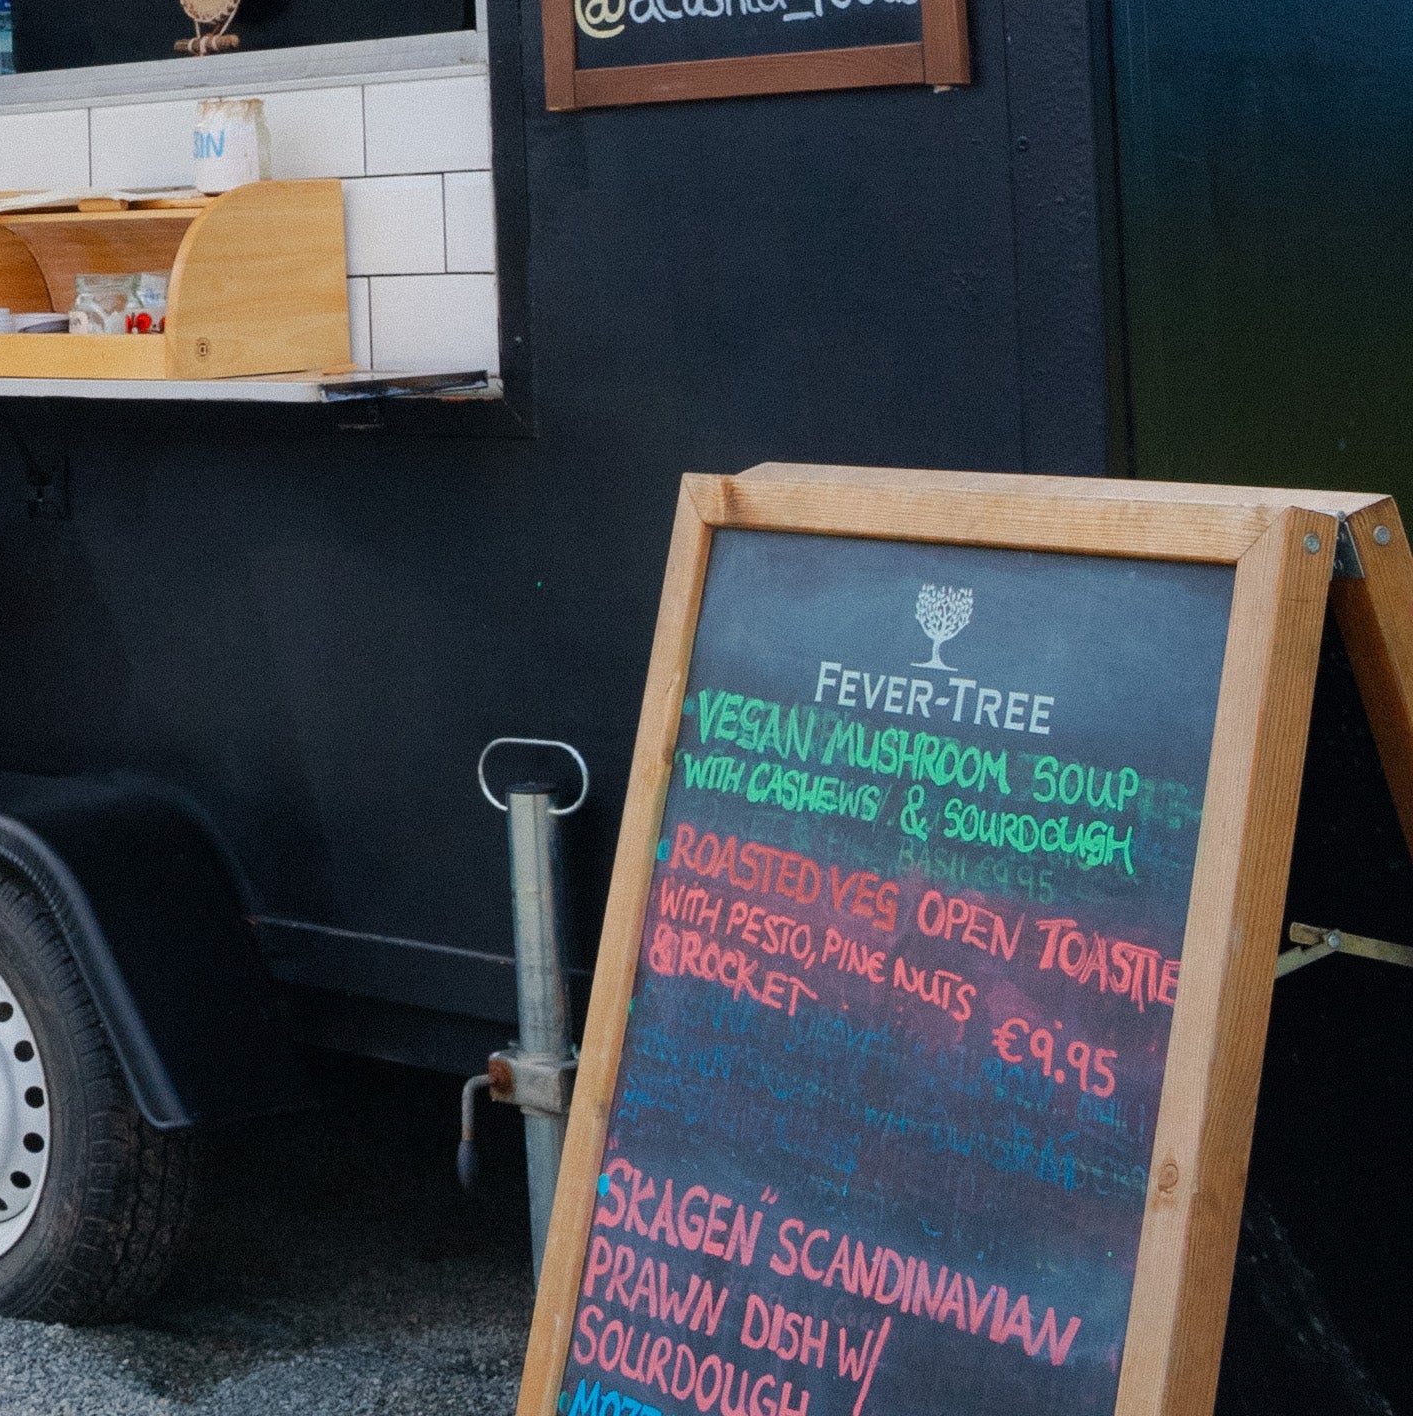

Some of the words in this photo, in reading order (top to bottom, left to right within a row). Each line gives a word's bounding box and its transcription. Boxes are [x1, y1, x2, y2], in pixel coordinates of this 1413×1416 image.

[696, 688, 818, 765] VEGAN
[821, 719, 1013, 796] MUSHROOM
[1032, 755, 1142, 813] SOUP
[813, 661, 1056, 735] FEVER-TREE
[683, 752, 744, 795] WITH
[746, 760, 881, 822] CASHEWS
[899, 785, 931, 843] &
[943, 798, 1136, 876] SOURDOUGH
[658, 879, 721, 935] WITH
[726, 899, 818, 971] PESTO,
[821, 934, 889, 986] PINE
[891, 961, 978, 1023] NUTS
[669, 821, 823, 907] ROASTED
[829, 864, 902, 934] VEG
[916, 889, 1028, 965] OPEN
[1035, 918, 1183, 1014] TOASTIE
[991, 1016, 1120, 1101] €9.95
[580, 1234, 730, 1338] PRAWN
[739, 1293, 830, 1369] DISH
[769, 1217, 1084, 1368] SCANDINAVIAN
[573, 1304, 811, 1416] SOURDOUGH
